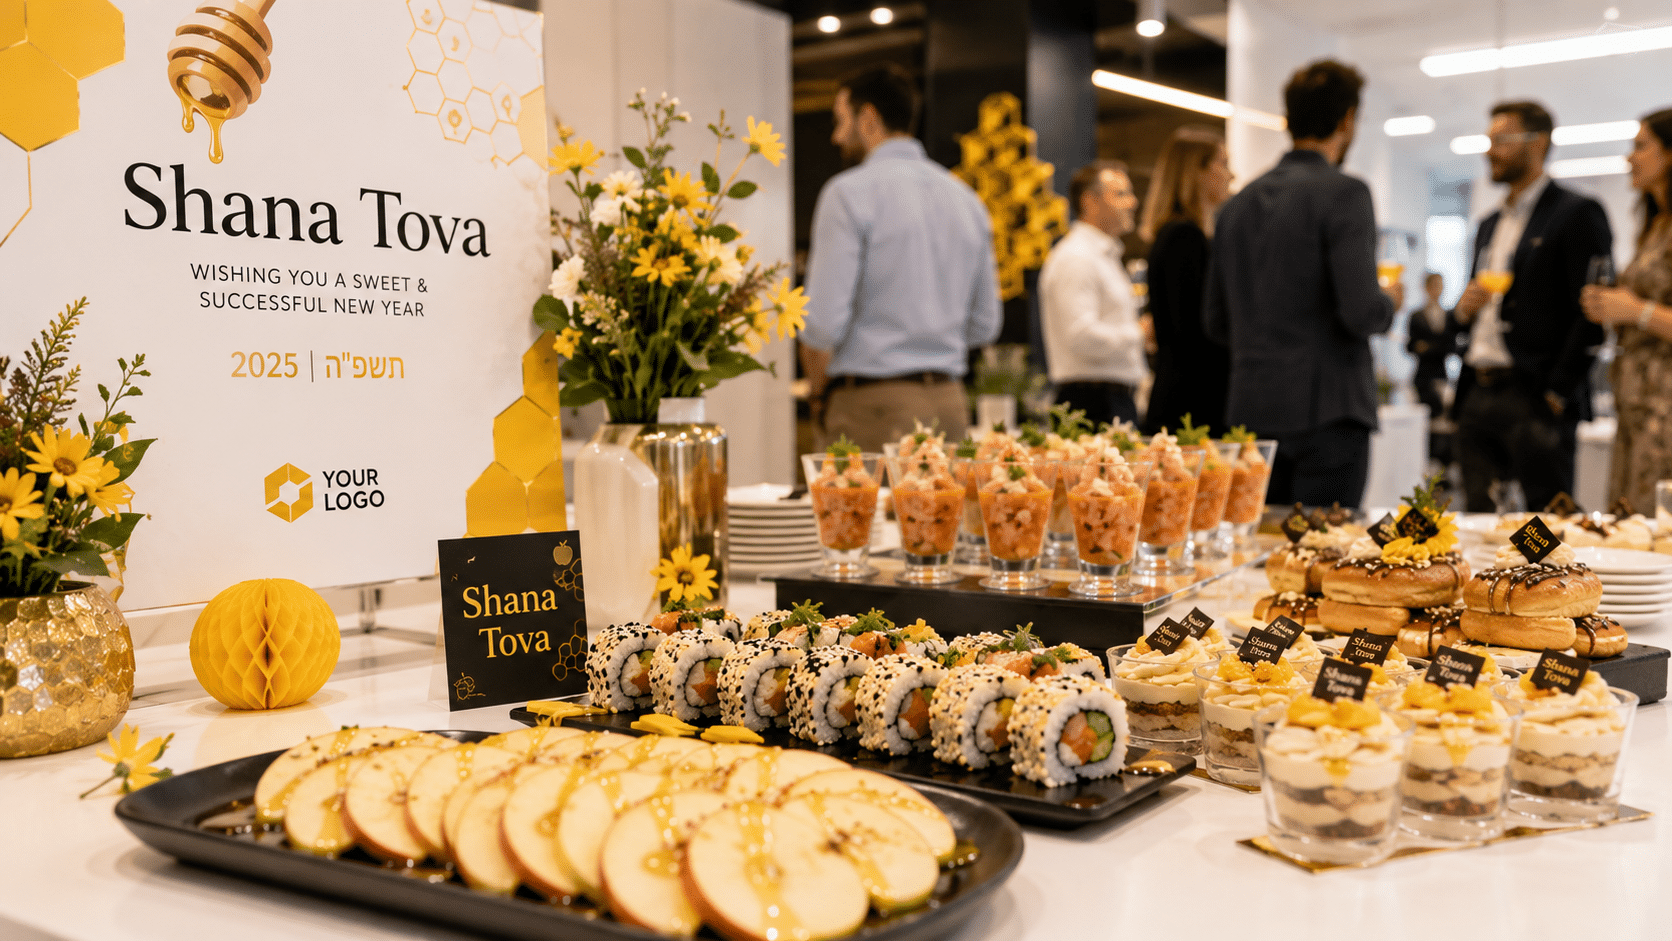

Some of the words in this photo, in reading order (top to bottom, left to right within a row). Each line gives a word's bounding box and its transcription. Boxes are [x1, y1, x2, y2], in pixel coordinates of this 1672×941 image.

[124, 162, 343, 245] Shana
[360, 187, 491, 258] Tova
[190, 264, 282, 284] WISHING
[287, 269, 328, 287] YOU
[334, 272, 347, 288] A
[352, 273, 411, 291] SWEET
[417, 277, 428, 293] &
[199, 291, 328, 313] SUCCESSFUL
[334, 297, 375, 315] NEW
[381, 299, 425, 317] YEAR
[231, 351, 299, 379] 2025
[322, 469, 379, 488] YOUR
[324, 490, 385, 511] LOGO
[462, 583, 558, 619] Shana
[478, 626, 552, 659] Tova
